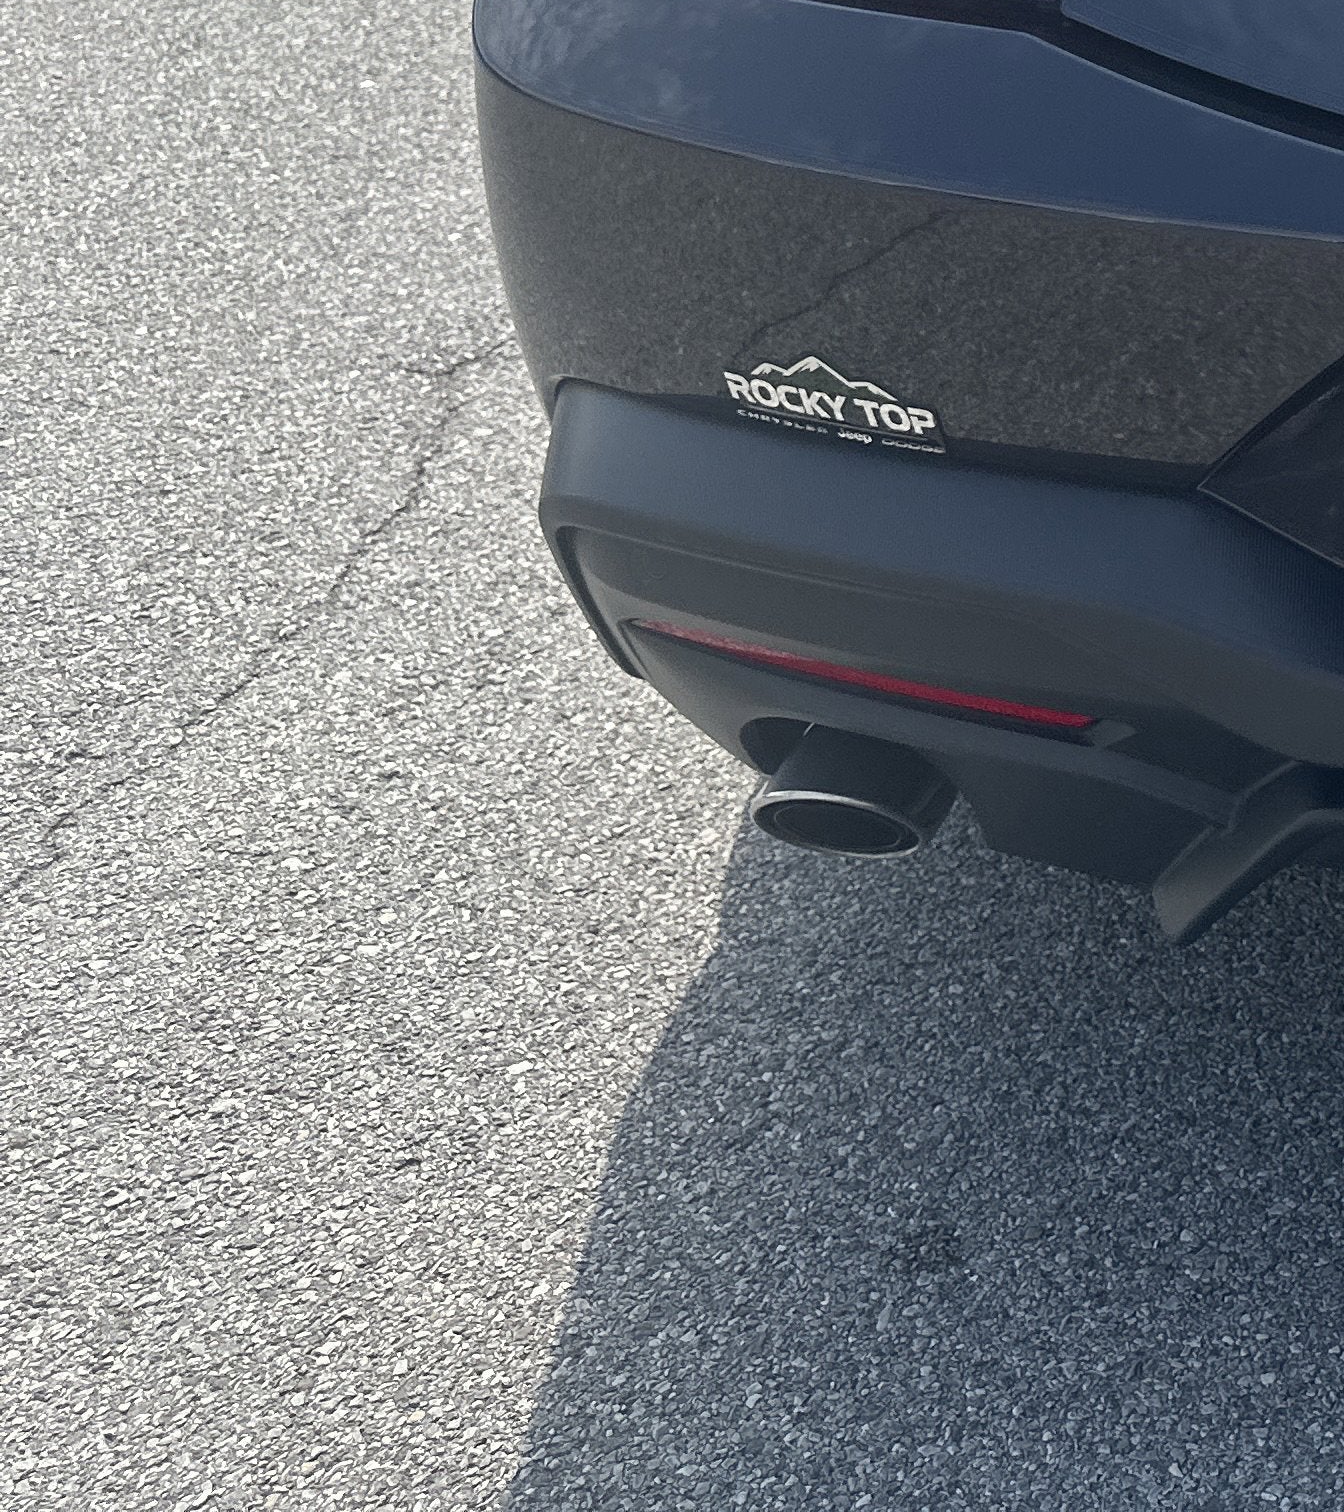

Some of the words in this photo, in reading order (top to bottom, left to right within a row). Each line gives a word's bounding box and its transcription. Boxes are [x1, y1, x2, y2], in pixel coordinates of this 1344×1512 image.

[724, 371, 846, 421] ROCKY
[853, 399, 936, 435] TOP
[837, 428, 873, 445] Jeep
